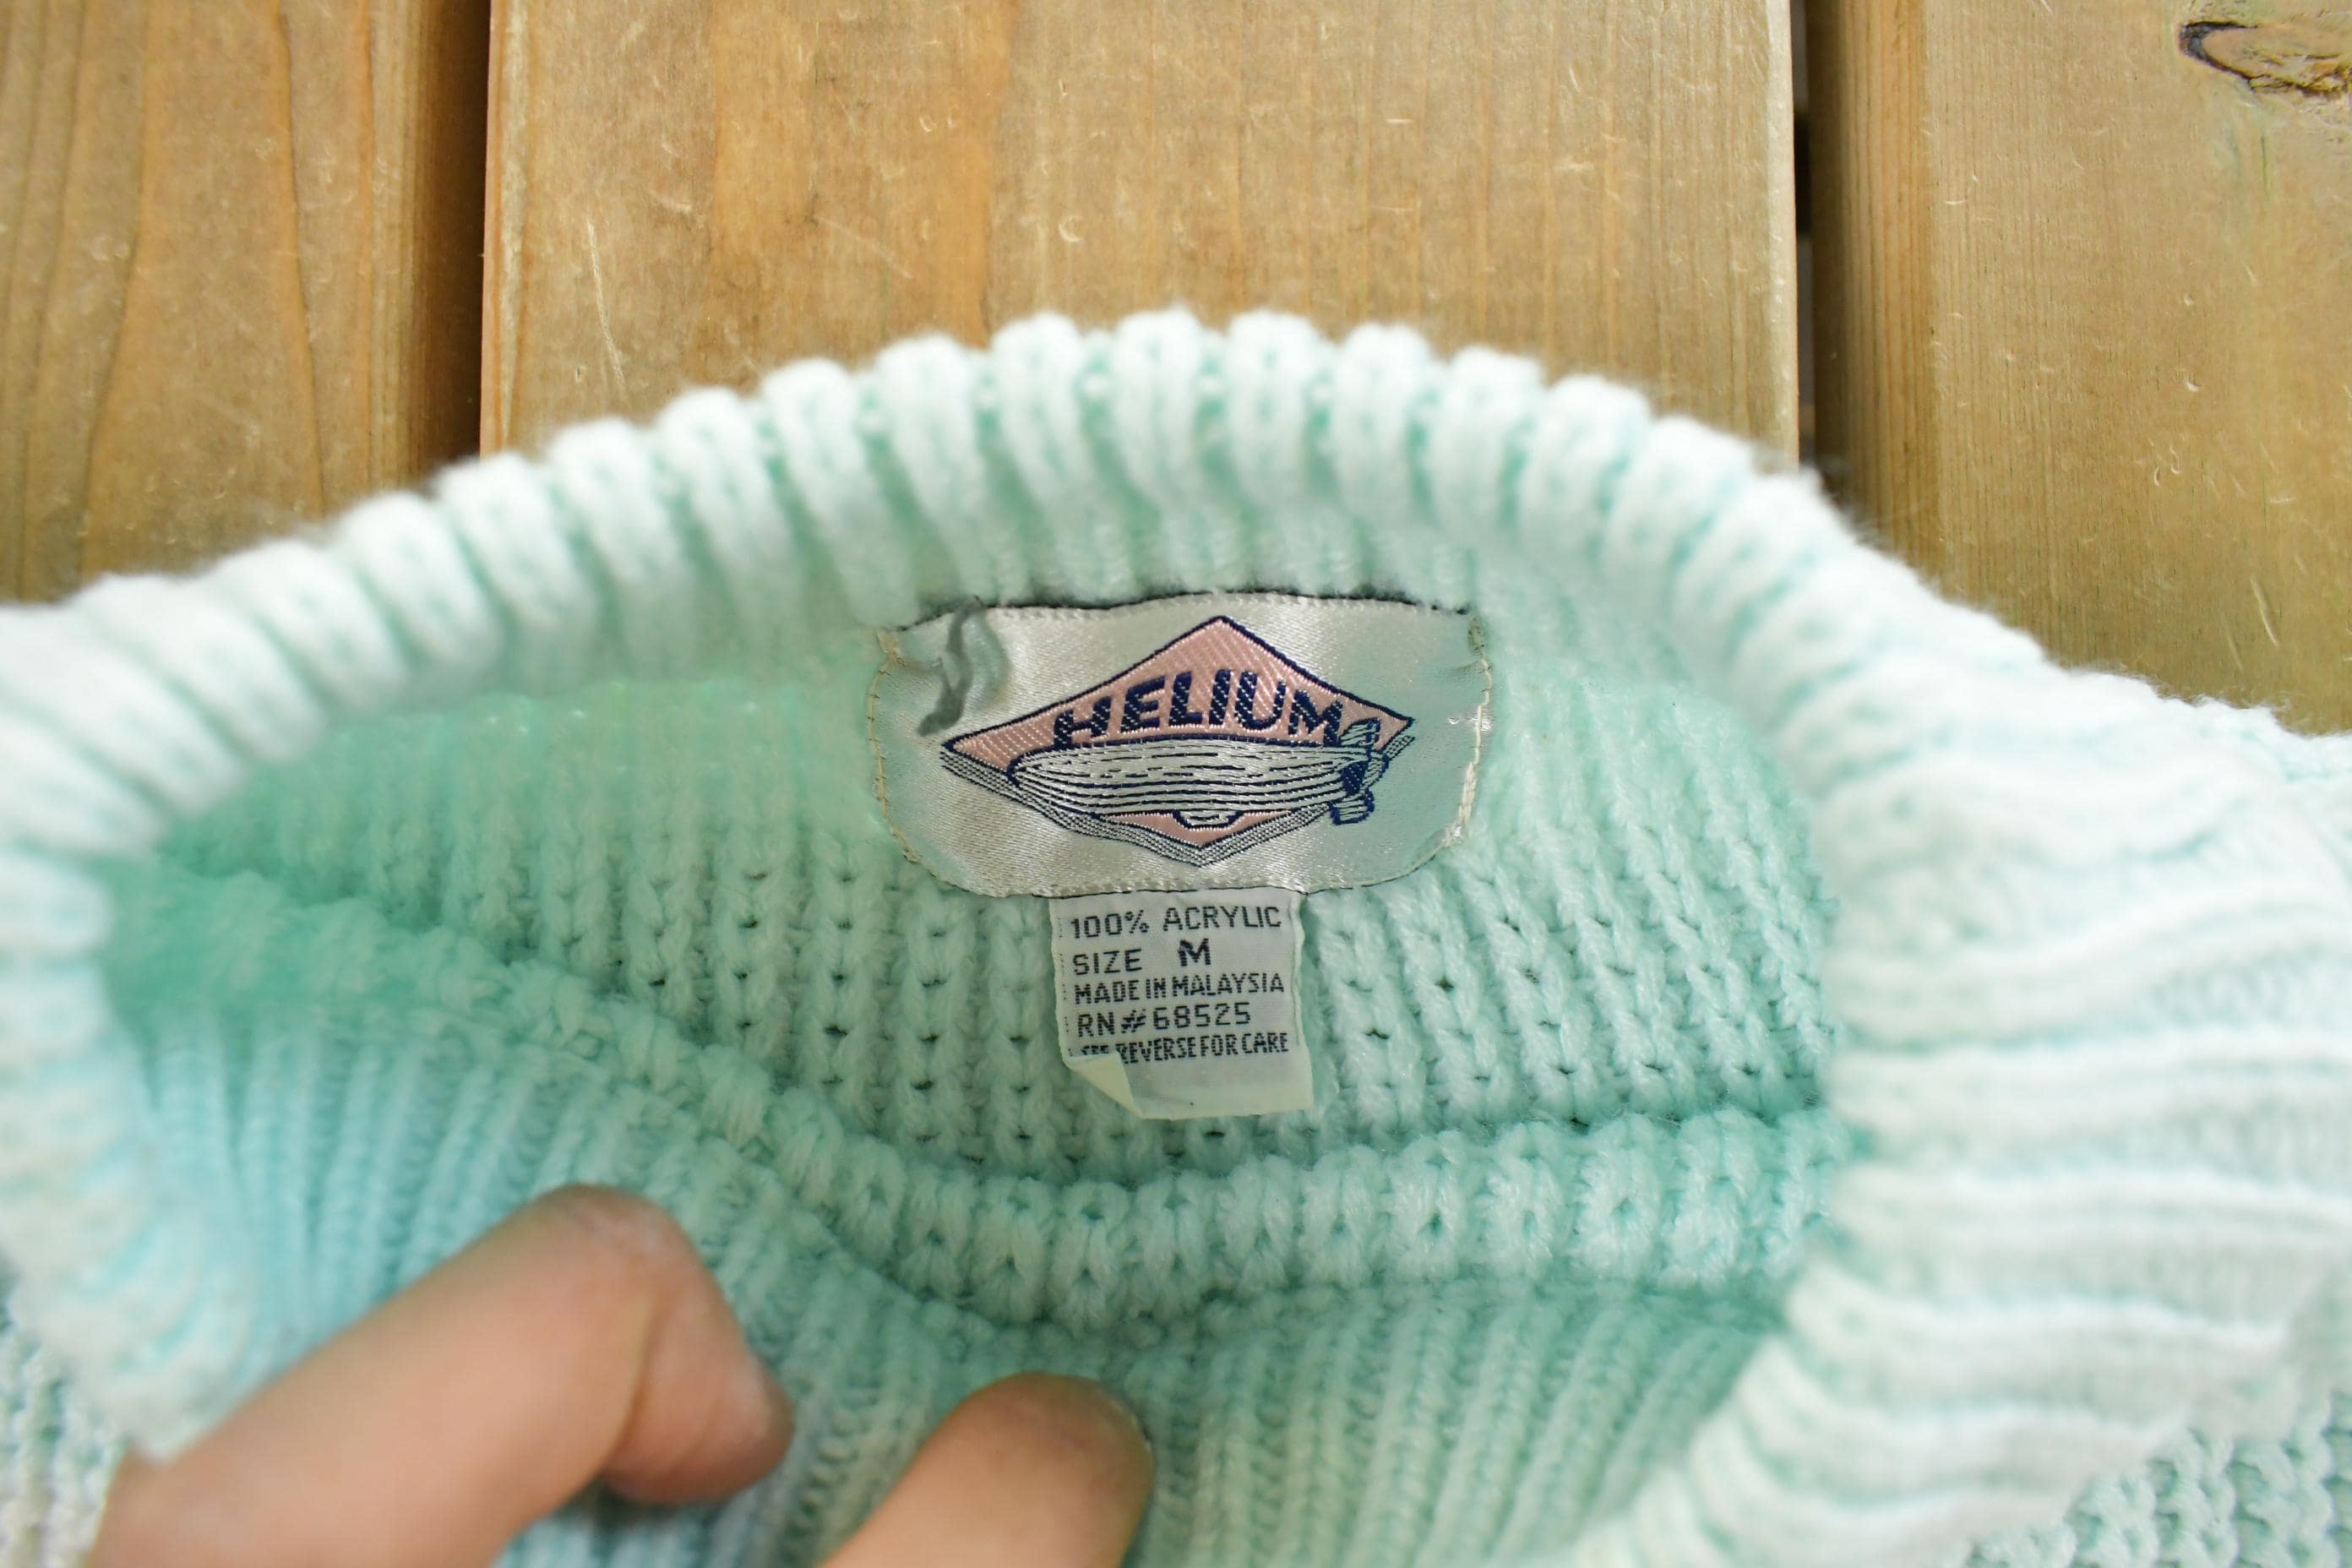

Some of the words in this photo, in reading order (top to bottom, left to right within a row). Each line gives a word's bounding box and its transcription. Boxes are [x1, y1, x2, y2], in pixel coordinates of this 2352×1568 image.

[1053, 668, 1343, 749] HELIUM
[1070, 910, 1149, 939] 100%
[1162, 906, 1282, 931] ACRYLIC
[1072, 948, 1142, 975] SIZE
[1177, 938, 1211, 967] M
[1075, 979, 1140, 1004] MADE
[1146, 977, 1167, 999] IN
[1172, 972, 1285, 998] MALAYSIA
[1115, 1036, 1197, 1064] REVERSE
[1200, 1034, 1239, 1057] FOR
[1242, 1032, 1289, 1054] CARE
